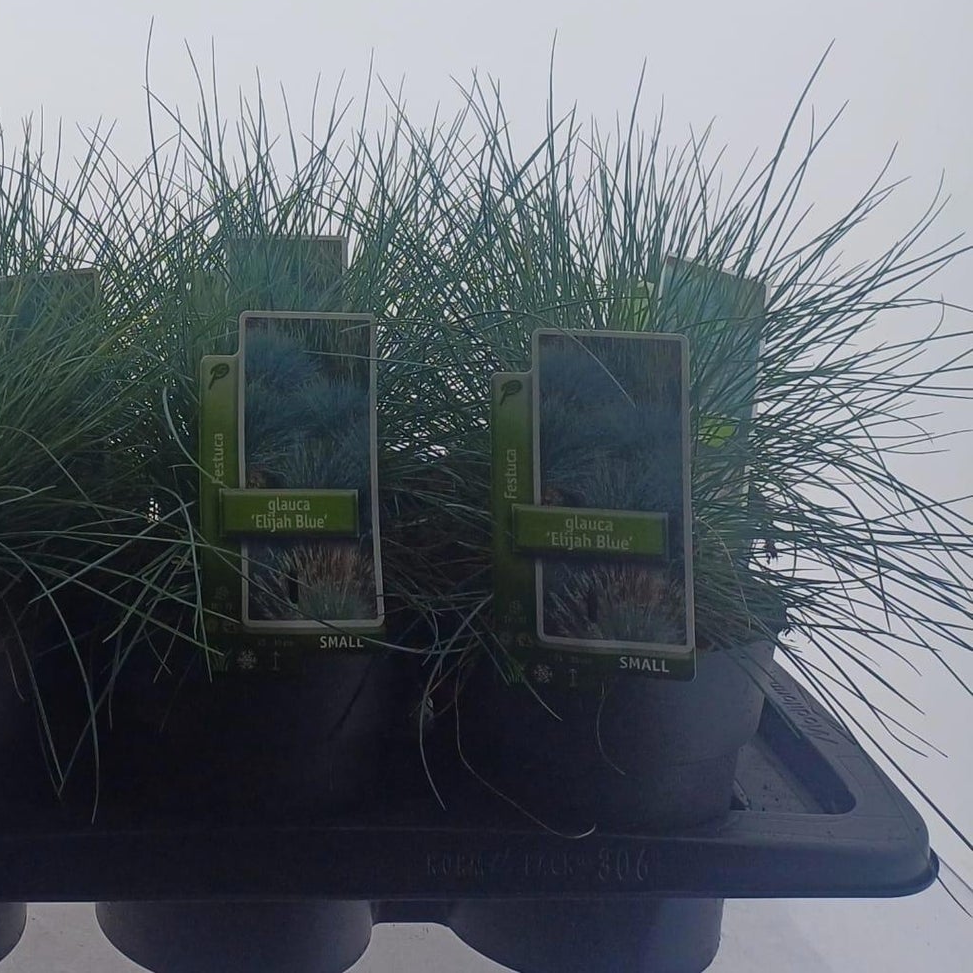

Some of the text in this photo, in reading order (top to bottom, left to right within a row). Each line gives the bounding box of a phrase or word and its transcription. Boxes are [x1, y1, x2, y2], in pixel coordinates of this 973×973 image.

[211, 433, 225, 485] Festuca
[504, 449, 517, 500] Festuca
[268, 498, 311, 514] glauca
[565, 516, 613, 533] glauca
[319, 635, 364, 649] SMALL
[619, 656, 670, 673] SMALL
